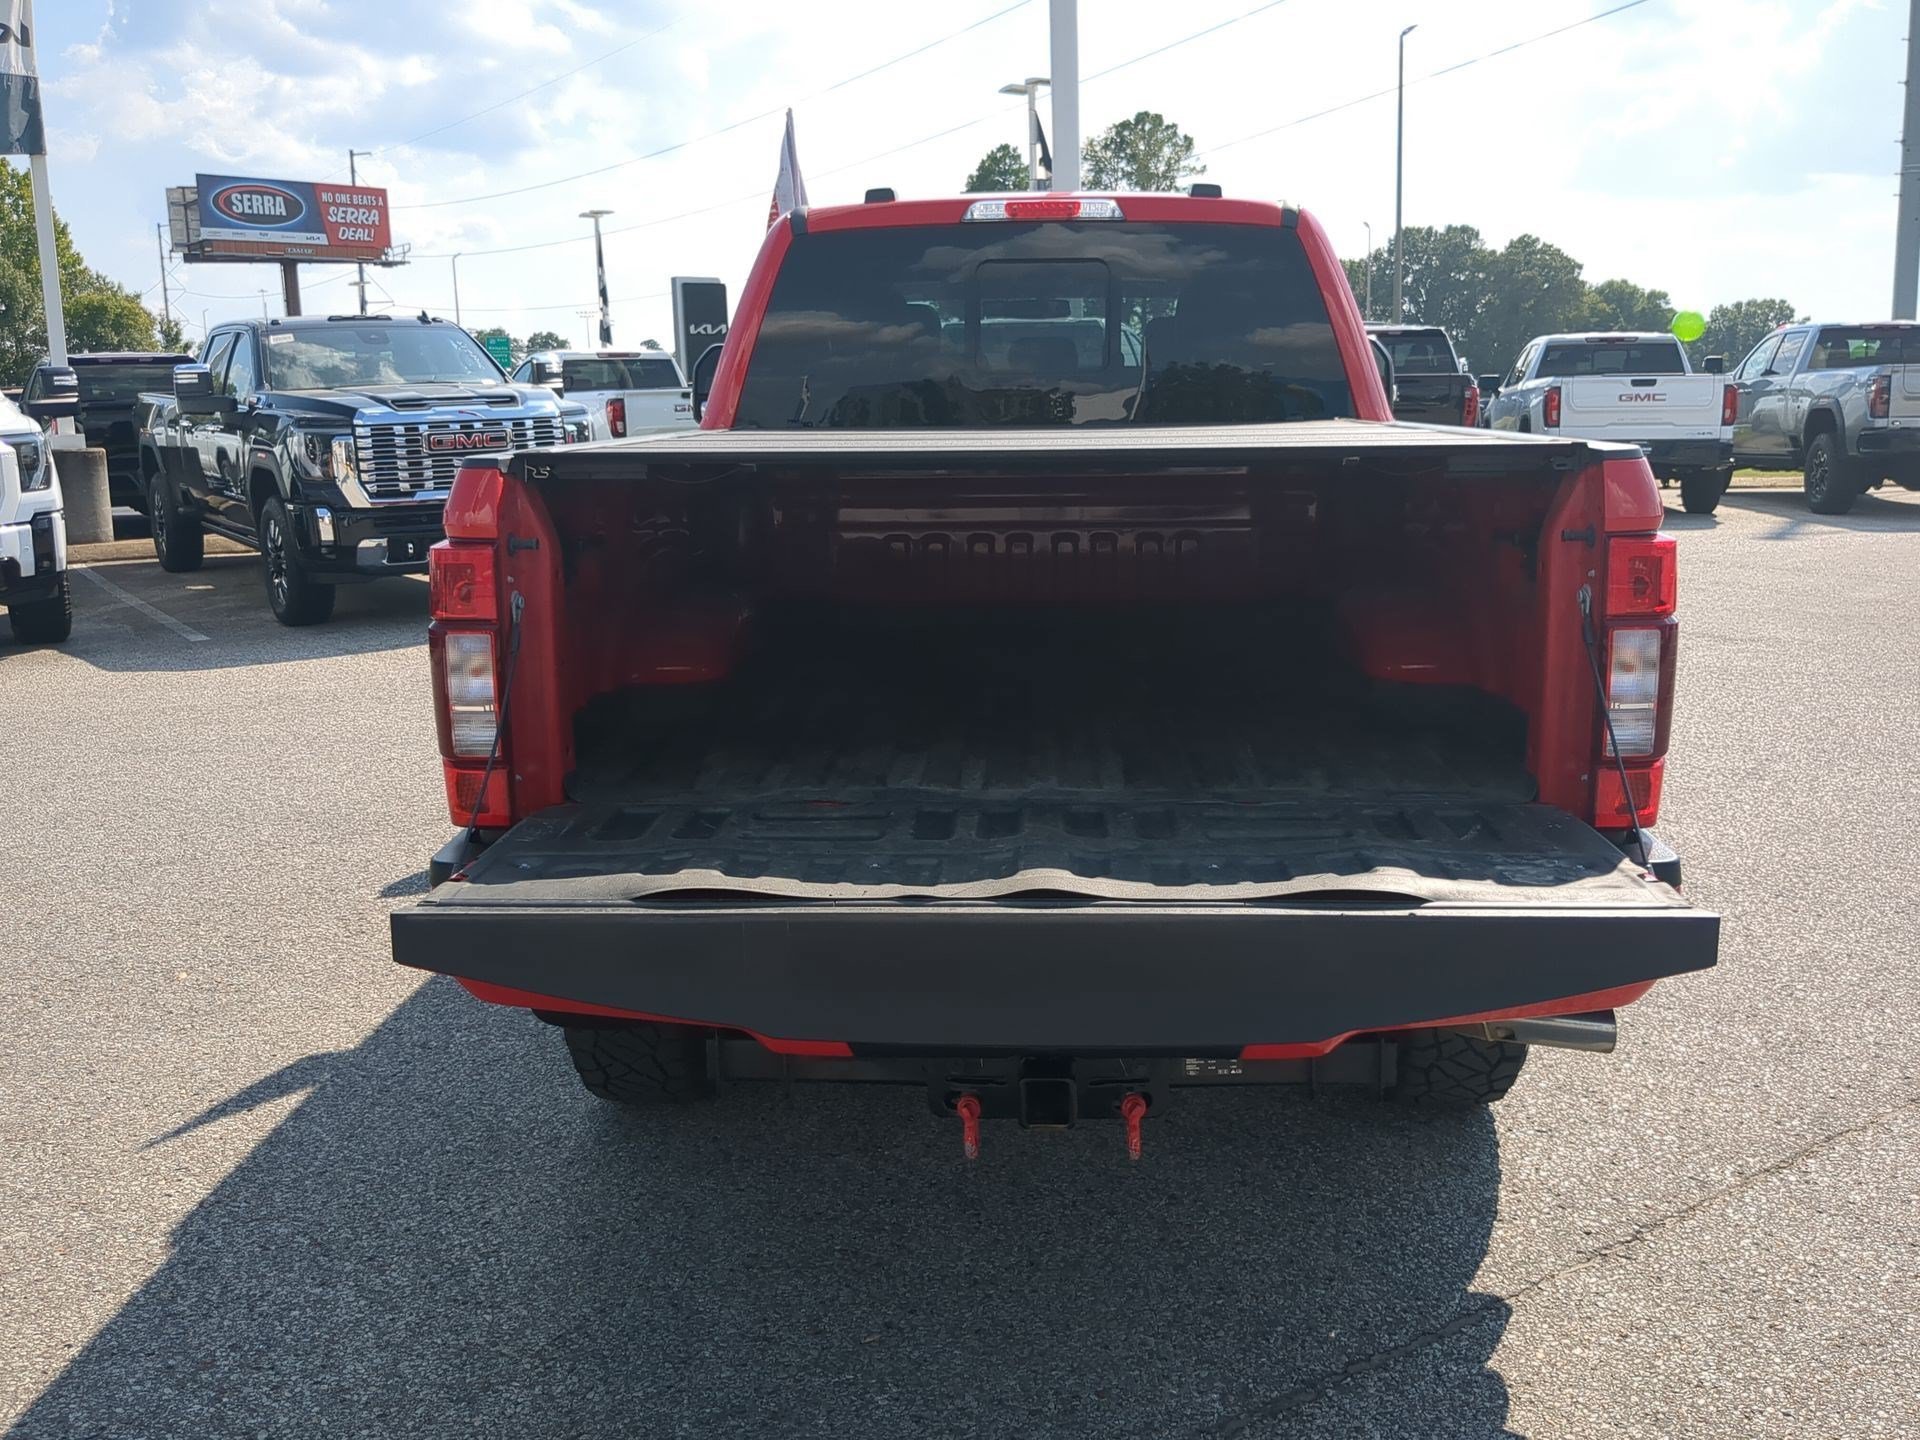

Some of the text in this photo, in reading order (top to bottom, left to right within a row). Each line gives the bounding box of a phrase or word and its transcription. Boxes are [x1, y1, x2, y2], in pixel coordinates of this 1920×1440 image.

[231, 193, 286, 216] SERRA
[321, 191, 384, 207] NO ONE BEATS A
[328, 206, 379, 225] SERRA
[338, 226, 375, 241] DEAL!
[689, 323, 727, 335] KIA
[1618, 393, 1667, 402] GMC
[430, 432, 507, 450] GMC
